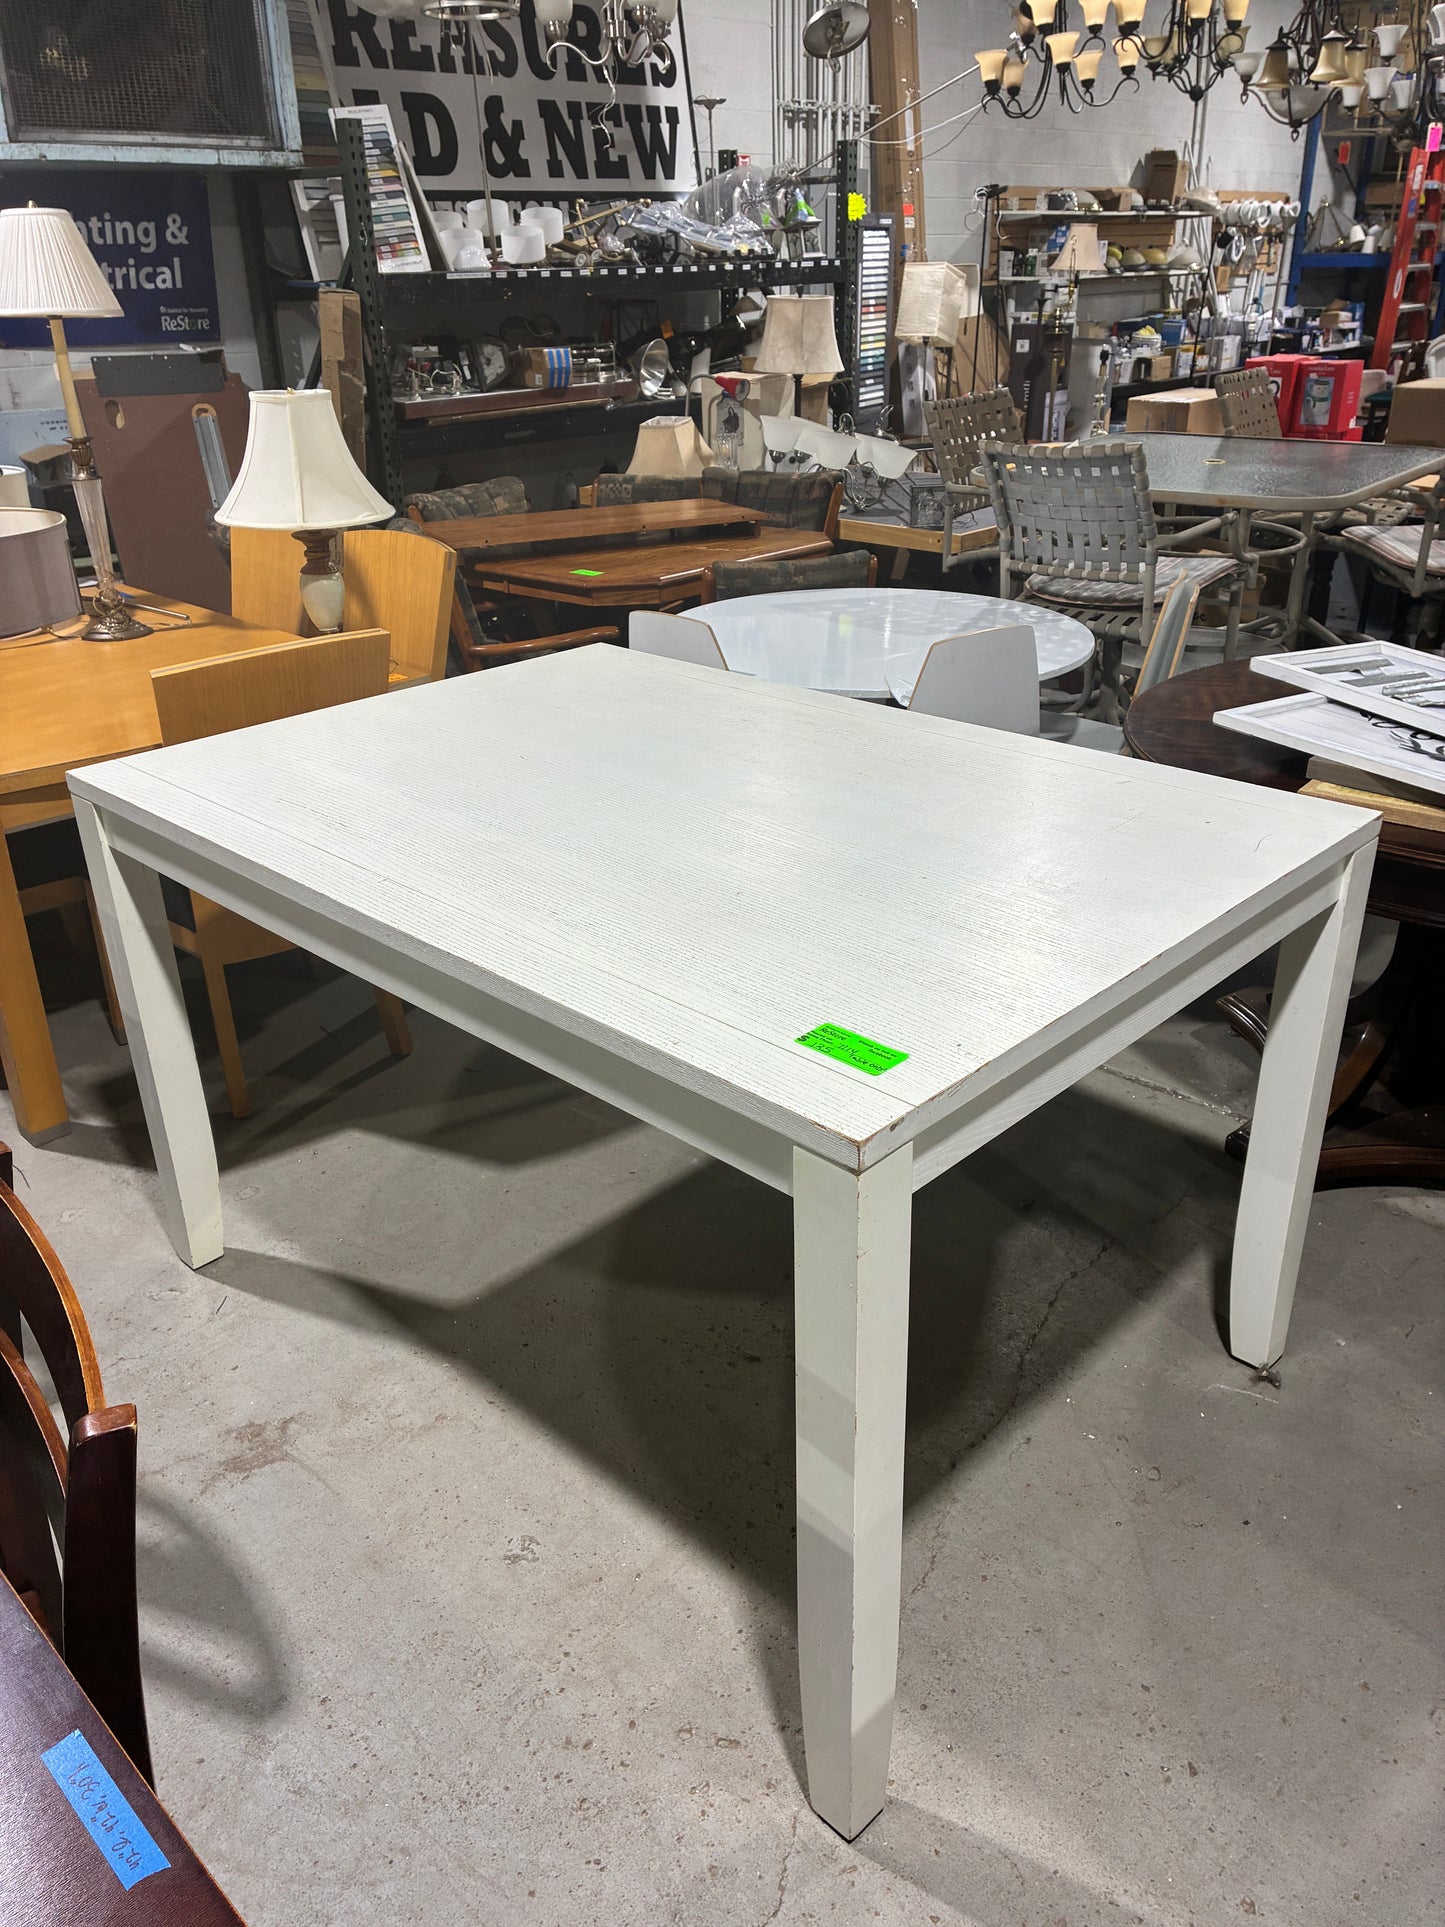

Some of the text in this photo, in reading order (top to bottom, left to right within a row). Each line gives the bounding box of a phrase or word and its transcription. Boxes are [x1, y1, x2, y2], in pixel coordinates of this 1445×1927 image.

[329, 0, 677, 88] REASURES
[483, 95, 531, 178] &
[537, 99, 680, 180] NEW
[76, 212, 189, 253] ting &
[101, 257, 182, 290] trical
[161, 316, 210, 331] ReStore
